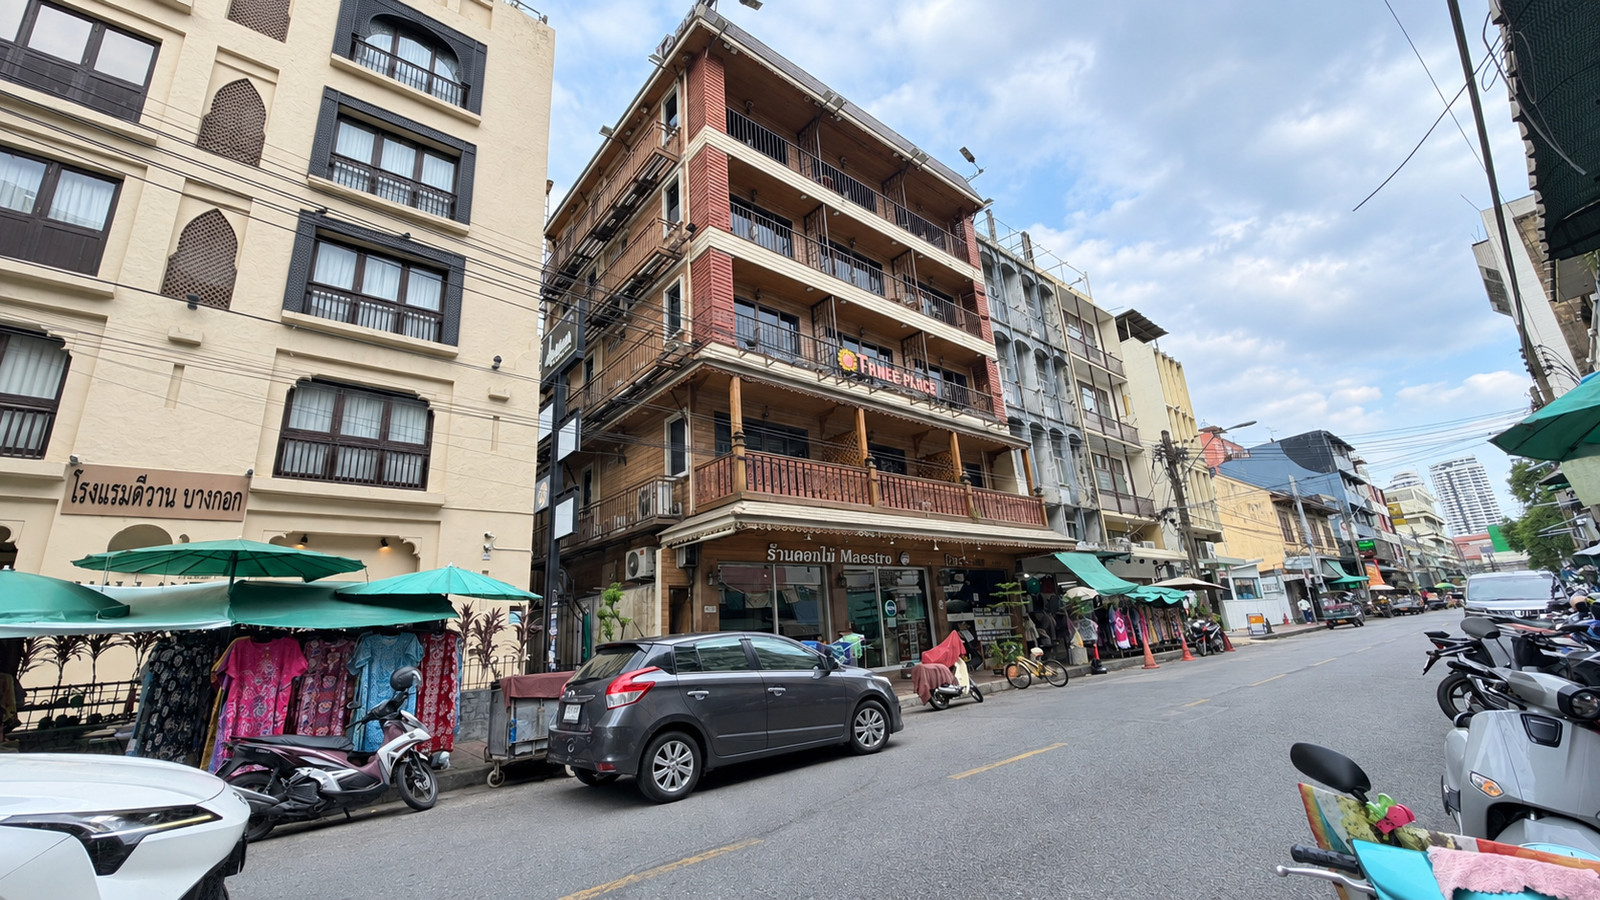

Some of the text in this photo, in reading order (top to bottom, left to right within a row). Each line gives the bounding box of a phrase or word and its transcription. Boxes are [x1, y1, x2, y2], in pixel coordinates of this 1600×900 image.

[903, 373, 938, 397] PLACE
[71, 469, 243, 512] โรงแรมดีวาน บางกอก
[840, 549, 893, 565] Maestro
